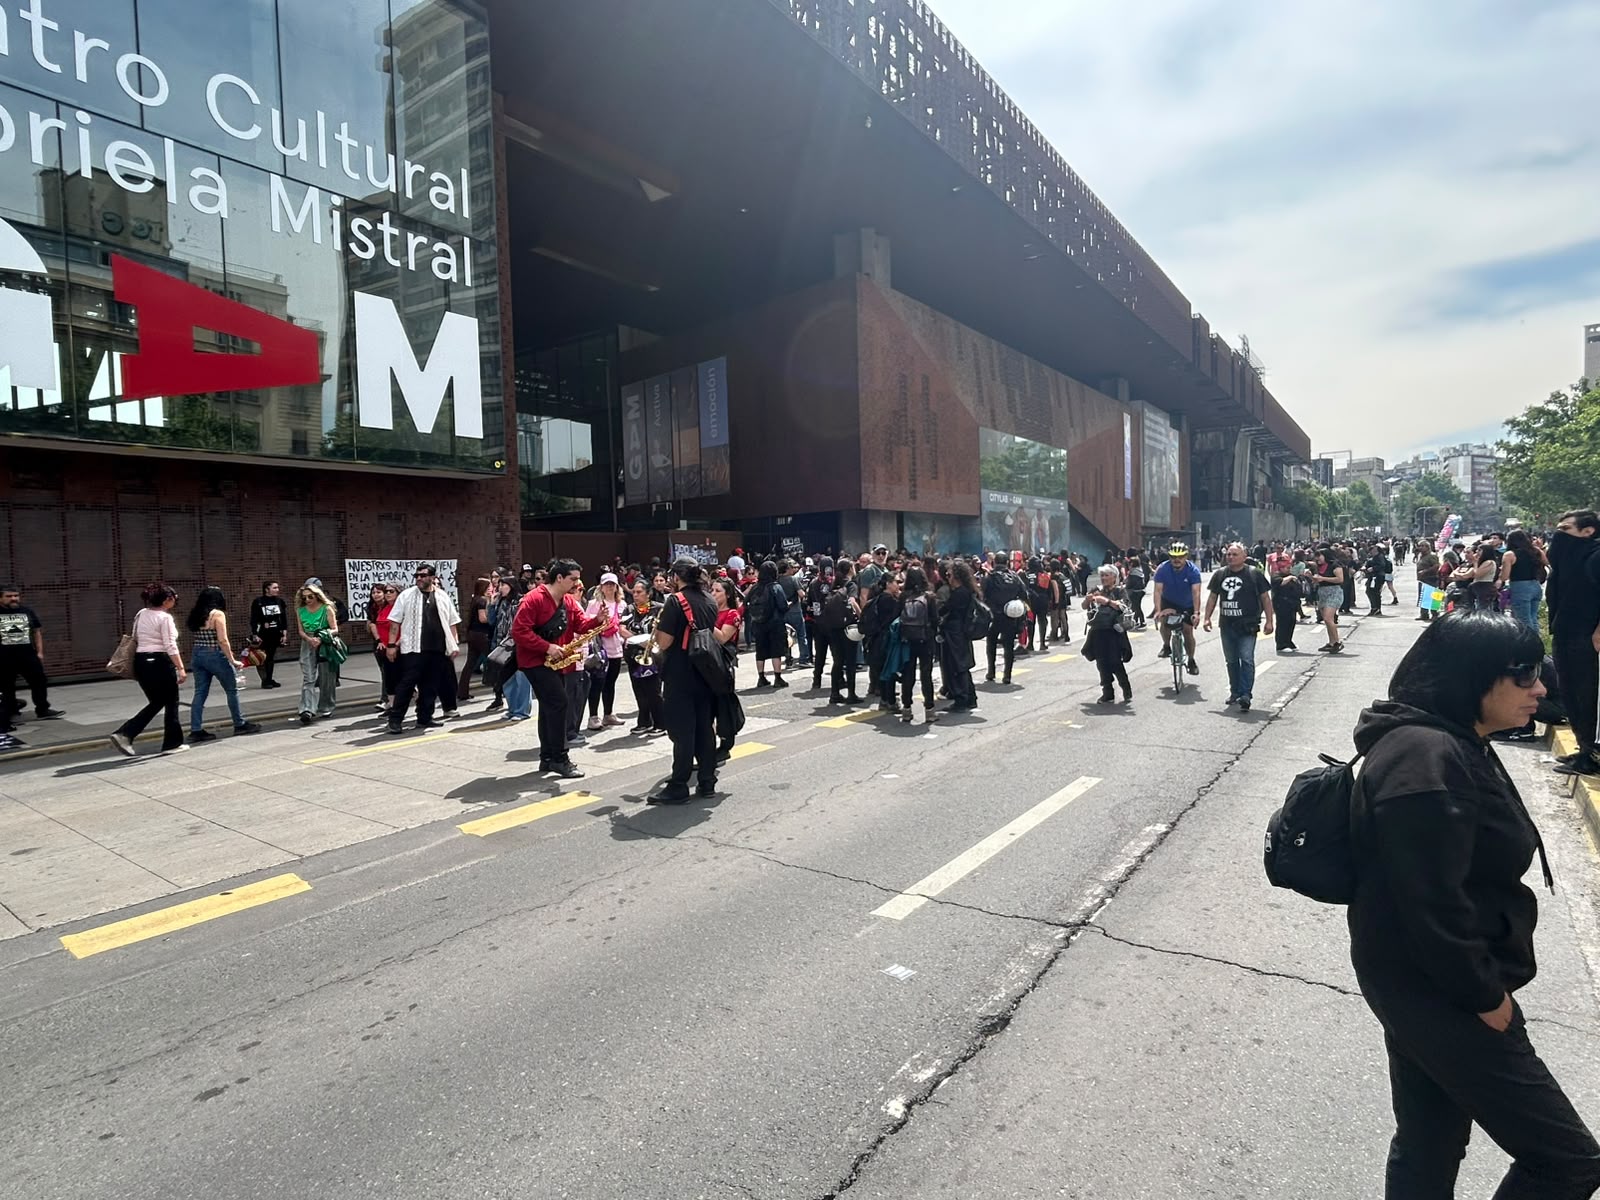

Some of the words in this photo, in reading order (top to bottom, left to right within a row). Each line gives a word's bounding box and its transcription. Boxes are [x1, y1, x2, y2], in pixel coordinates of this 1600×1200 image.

[0, 0, 169, 107] tro
[206, 73, 469, 219] Cultural
[270, 173, 472, 287] Mistral
[626, 394, 643, 480] GAM
[348, 573, 358, 582] EN
[360, 573, 370, 582] LA
